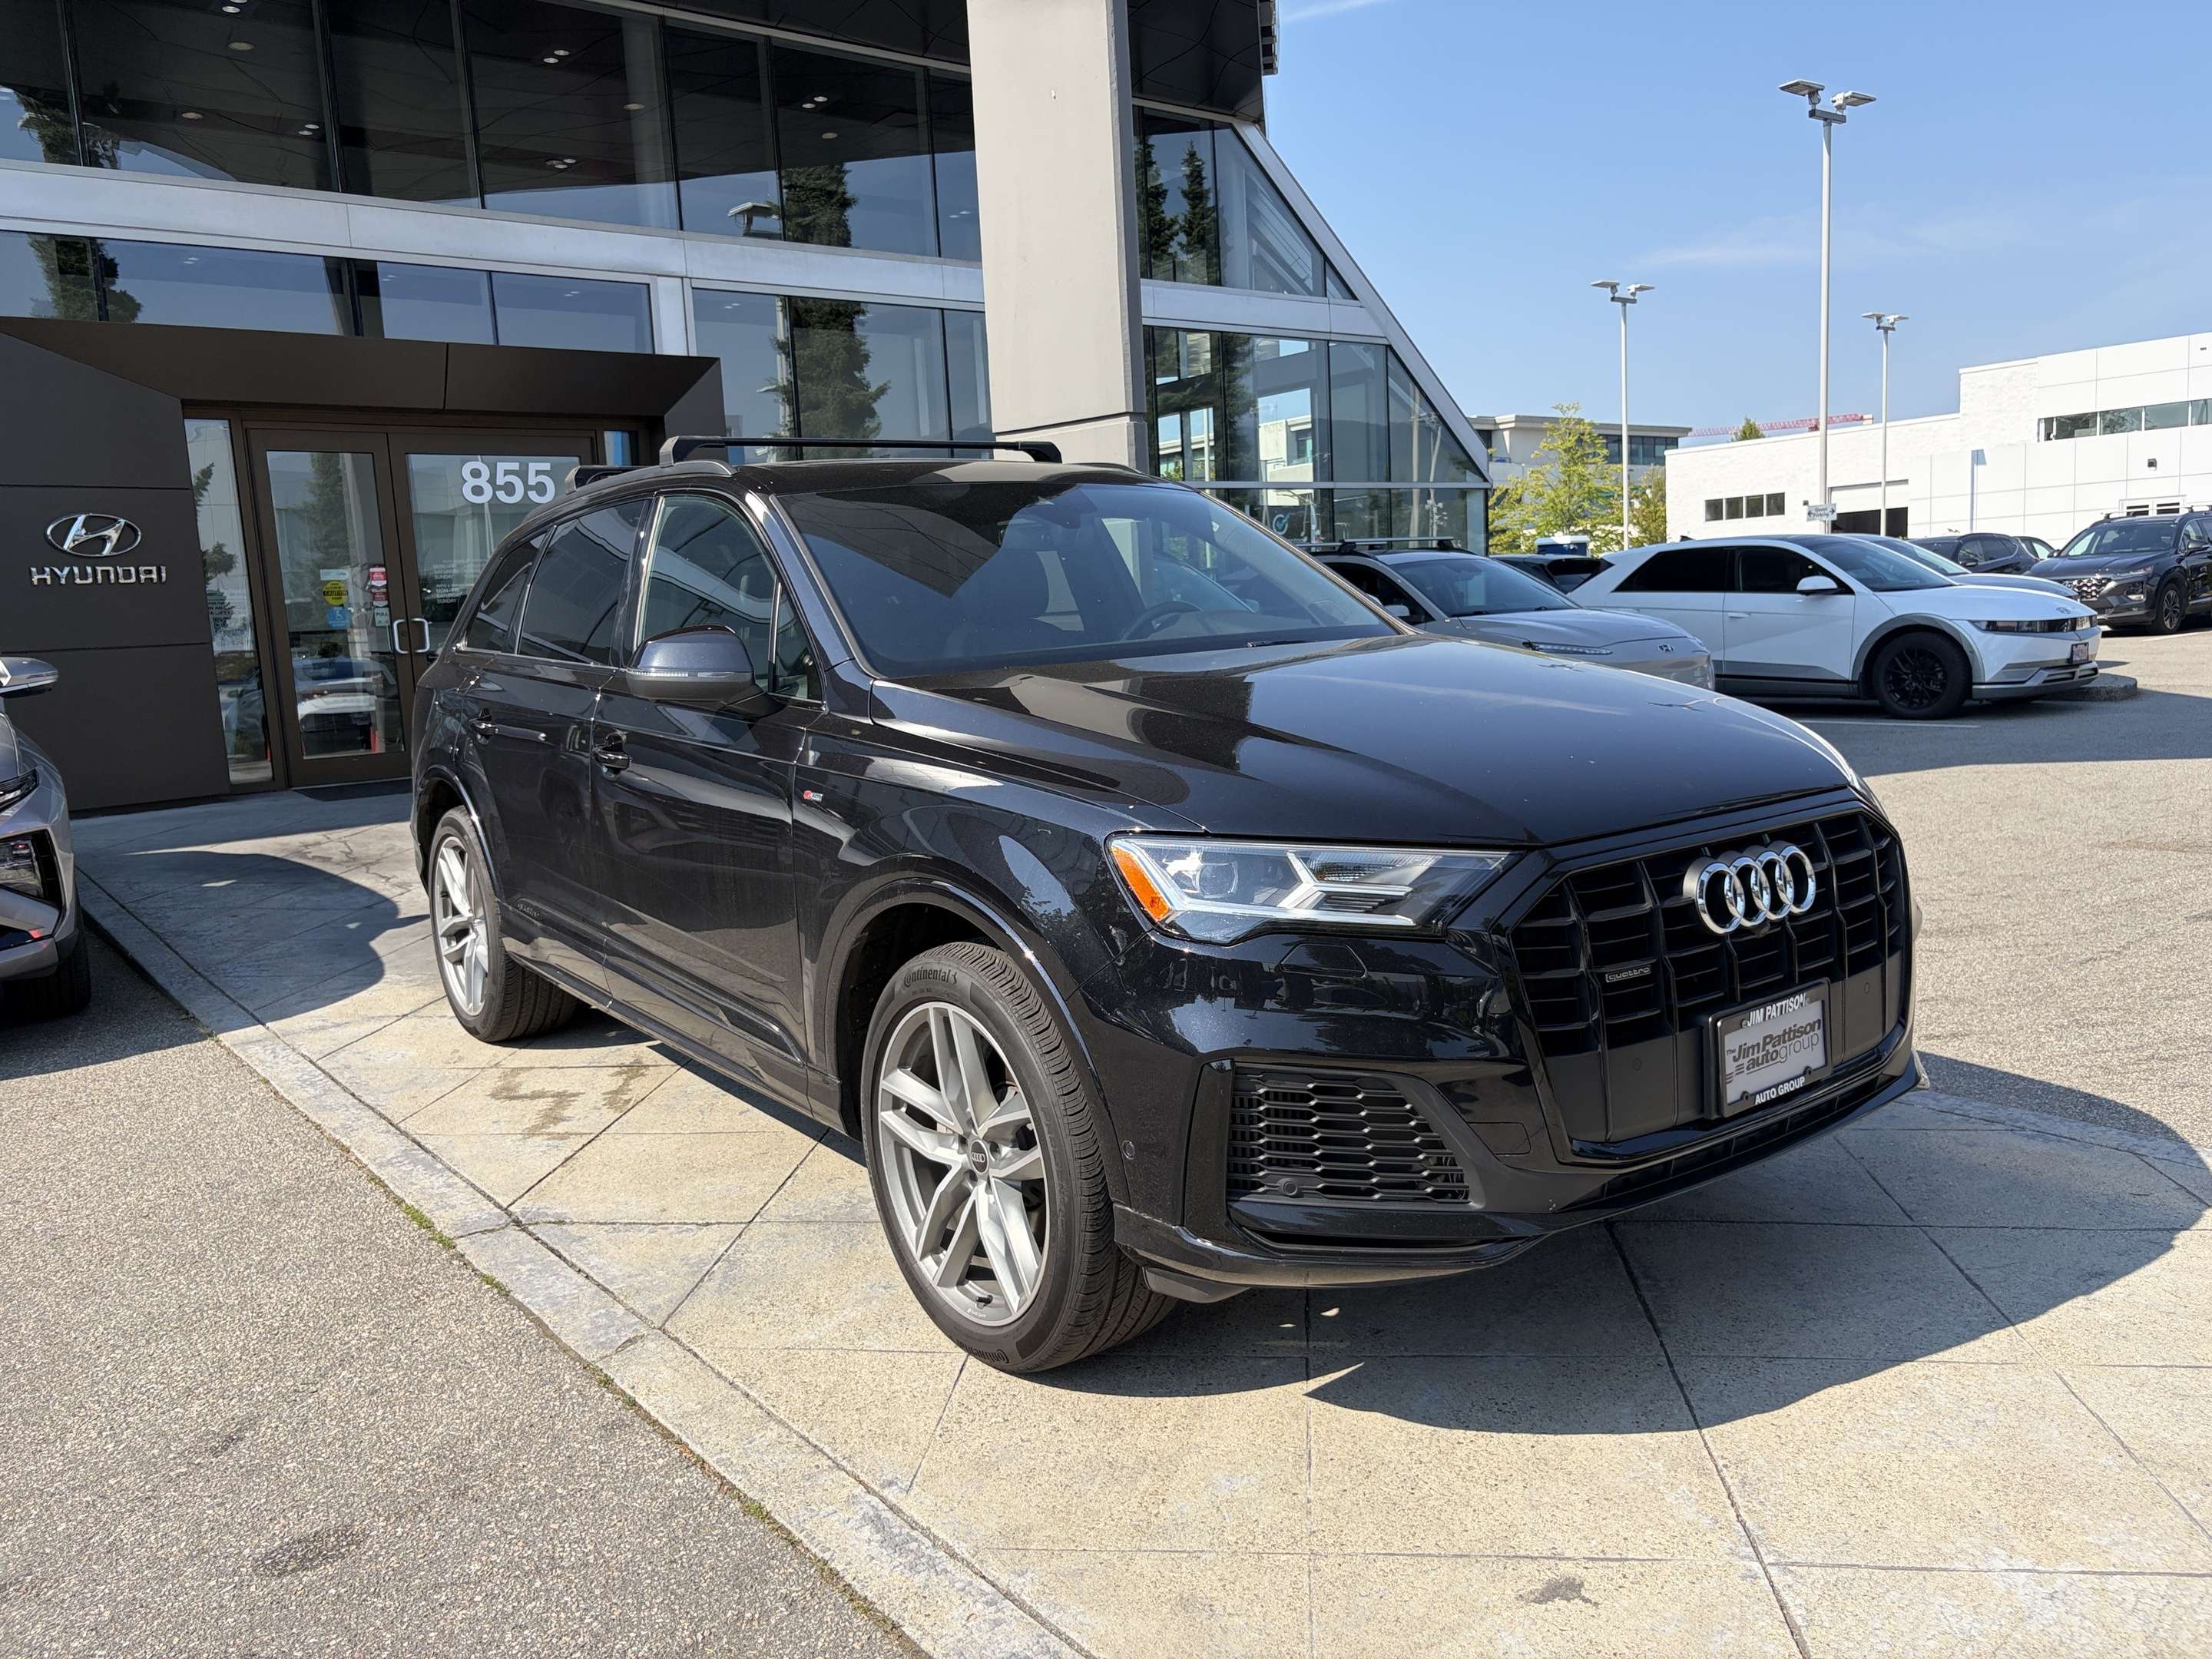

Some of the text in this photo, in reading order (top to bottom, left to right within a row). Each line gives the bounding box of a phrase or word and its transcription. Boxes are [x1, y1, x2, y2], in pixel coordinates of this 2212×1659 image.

[462, 461, 555, 504] 855
[30, 565, 167, 585] HYUNDAI
[904, 966, 952, 988] Continental
[1608, 967, 1650, 982] quattro
[1747, 992, 1806, 1027] JIM PATTISON
[1732, 1041, 1760, 1063] Jim
[1761, 1018, 1822, 1053] Pattison
[1754, 1076, 1806, 1106] AUTO GROUP
